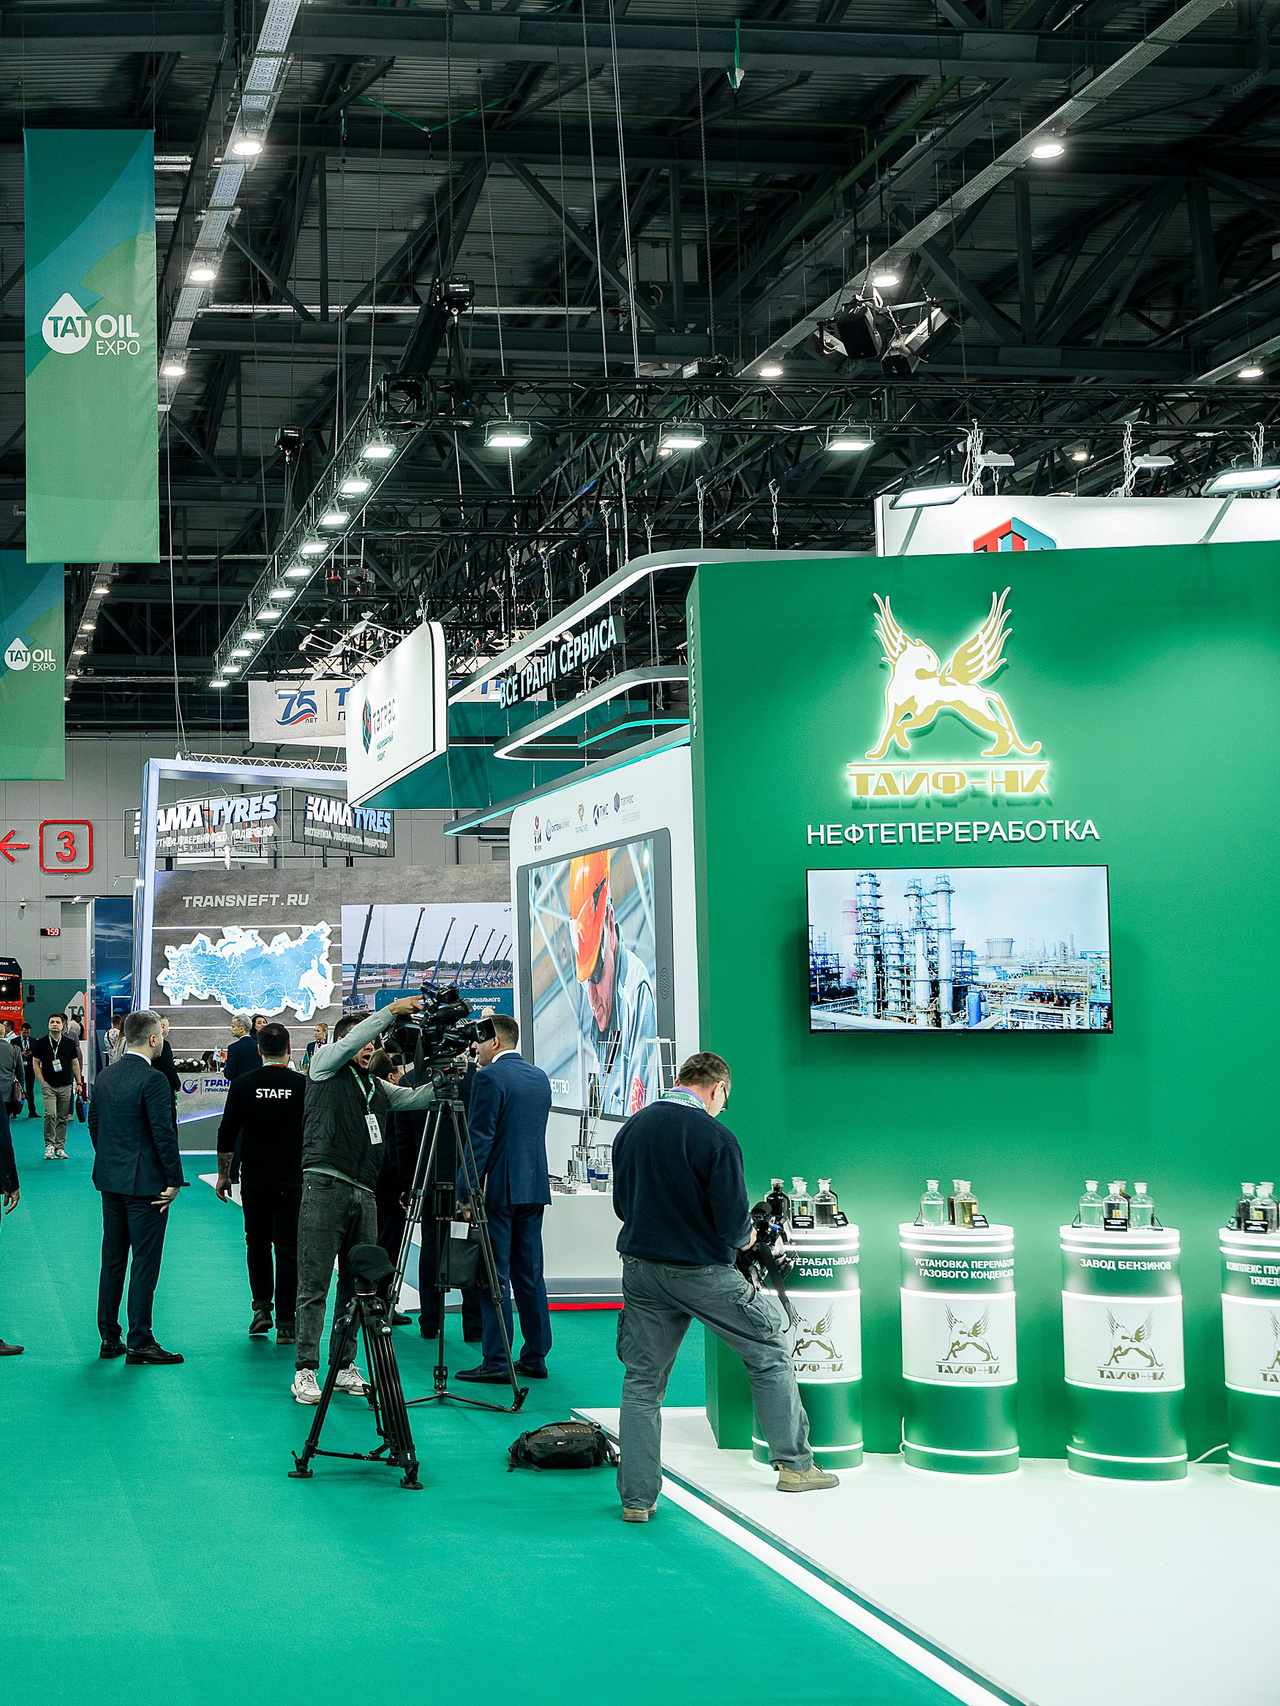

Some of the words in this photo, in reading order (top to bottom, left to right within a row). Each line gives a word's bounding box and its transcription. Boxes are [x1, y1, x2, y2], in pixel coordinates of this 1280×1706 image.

[95, 314, 140, 339] OIL
[96, 340, 141, 356] EXPO
[32, 648, 56, 662] OIL
[500, 675, 519, 710] ВСЕ
[520, 651, 557, 699] ГРАНИ
[559, 615, 617, 675] СЕРВИСА
[32, 662, 56, 672] EXPO
[277, 690, 318, 720] 75
[210, 794, 278, 826] TYRES
[353, 808, 391, 835] TYRES
[806, 819, 1100, 845] НЕФТЕПЕРЕРАБОТКА
[56, 831, 77, 862] 3
[182, 894, 310, 908] TRANSNEFT.RU
[204, 1079, 230, 1087] ТРАН
[550, 1078, 570, 1094] ЕСТВО
[256, 1088, 292, 1099] STAFF
[914, 1257, 969, 1269] УСТАНОВКА
[1080, 1258, 1116, 1270] ЗАВОД
[1117, 1260, 1171, 1270] БЕНЗИНОВ
[799, 1268, 833, 1277] ЗАВОД
[919, 1269, 969, 1279] ГАЗОВОГО
